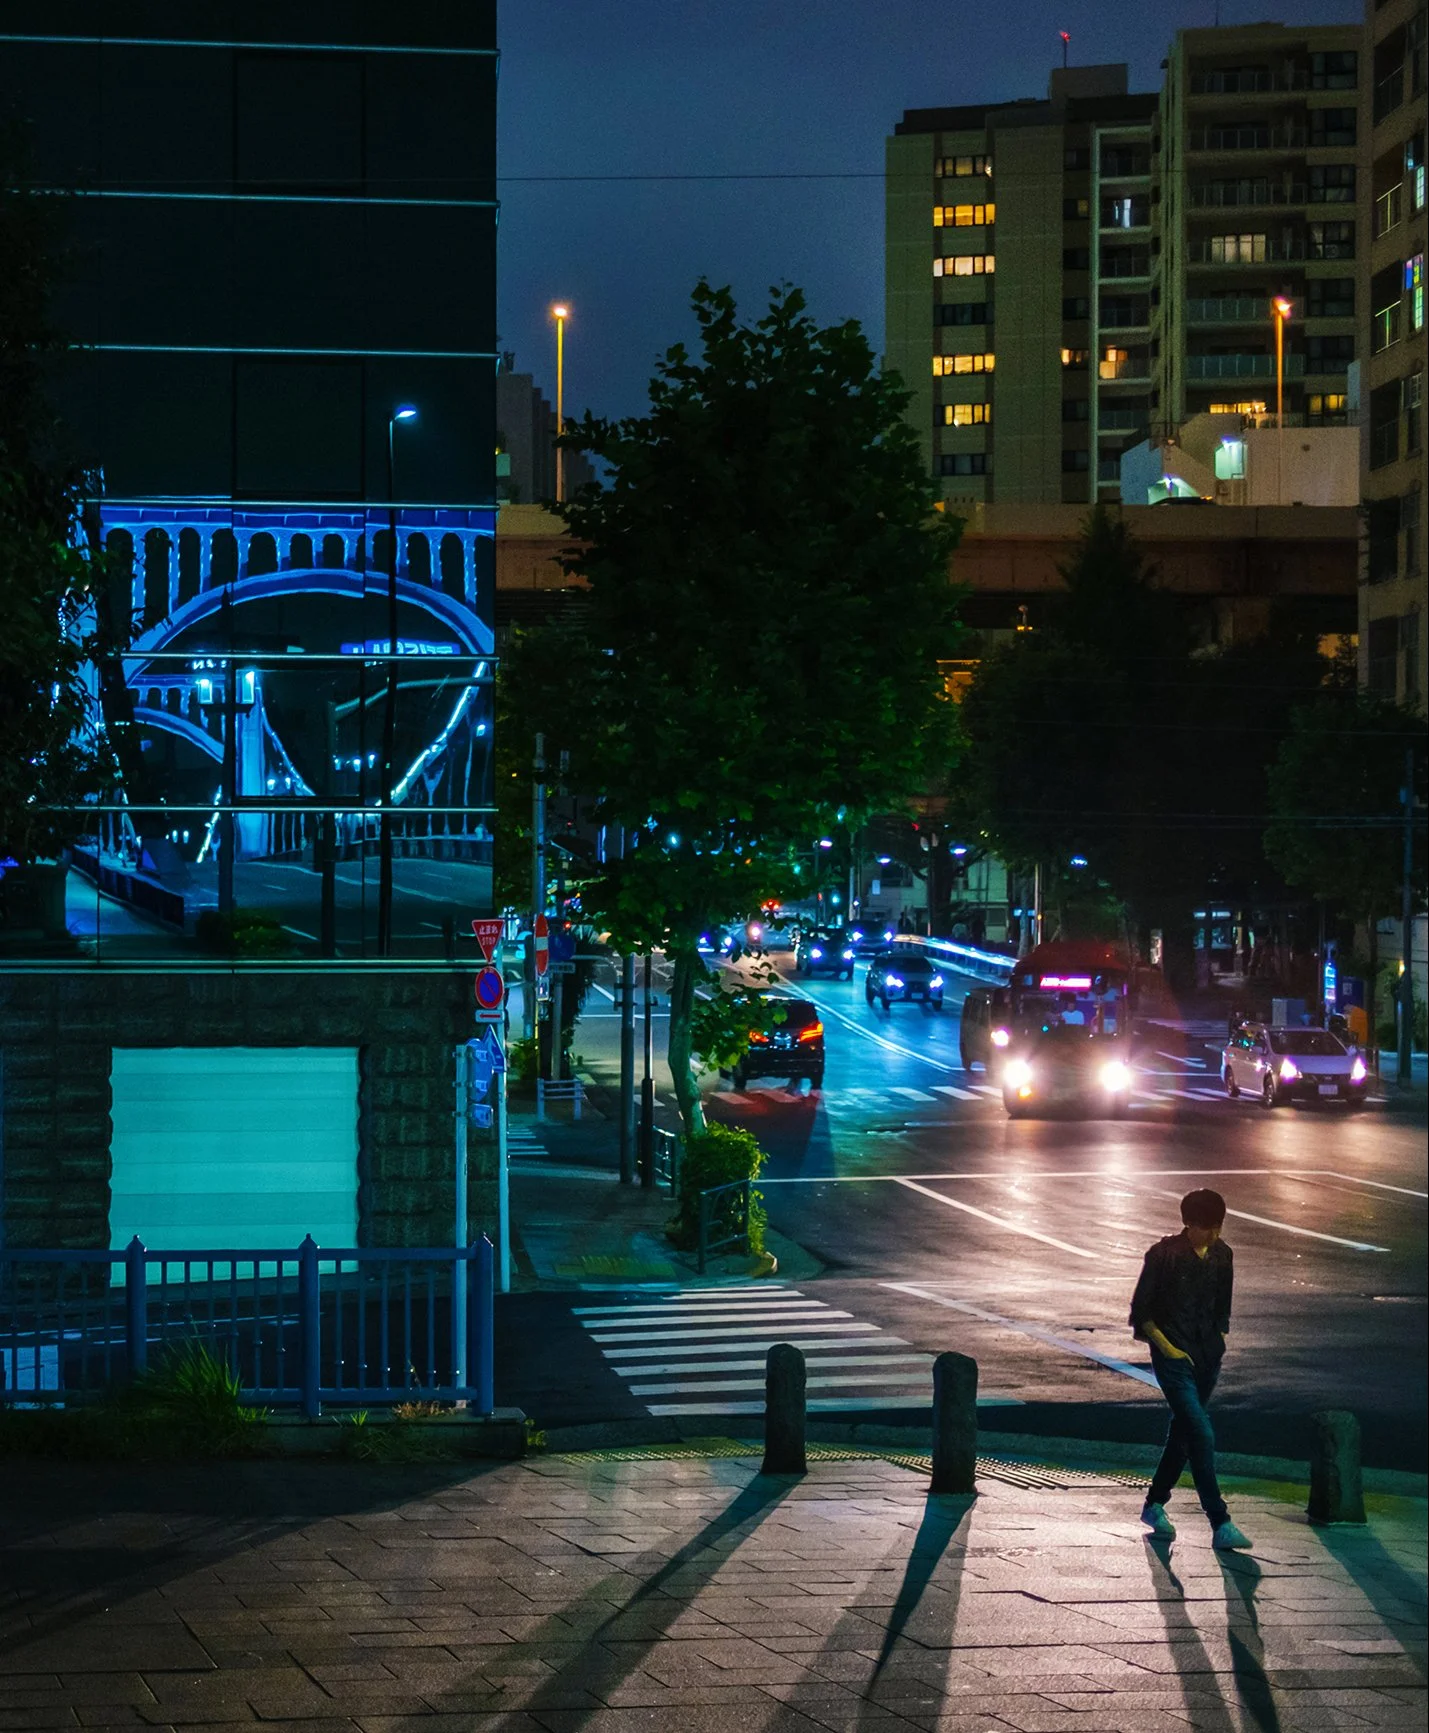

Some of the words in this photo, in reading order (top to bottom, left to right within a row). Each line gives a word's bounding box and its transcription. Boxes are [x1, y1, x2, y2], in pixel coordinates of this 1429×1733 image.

[479, 925, 498, 935] 止まれ
[482, 937, 496, 946] STOP
